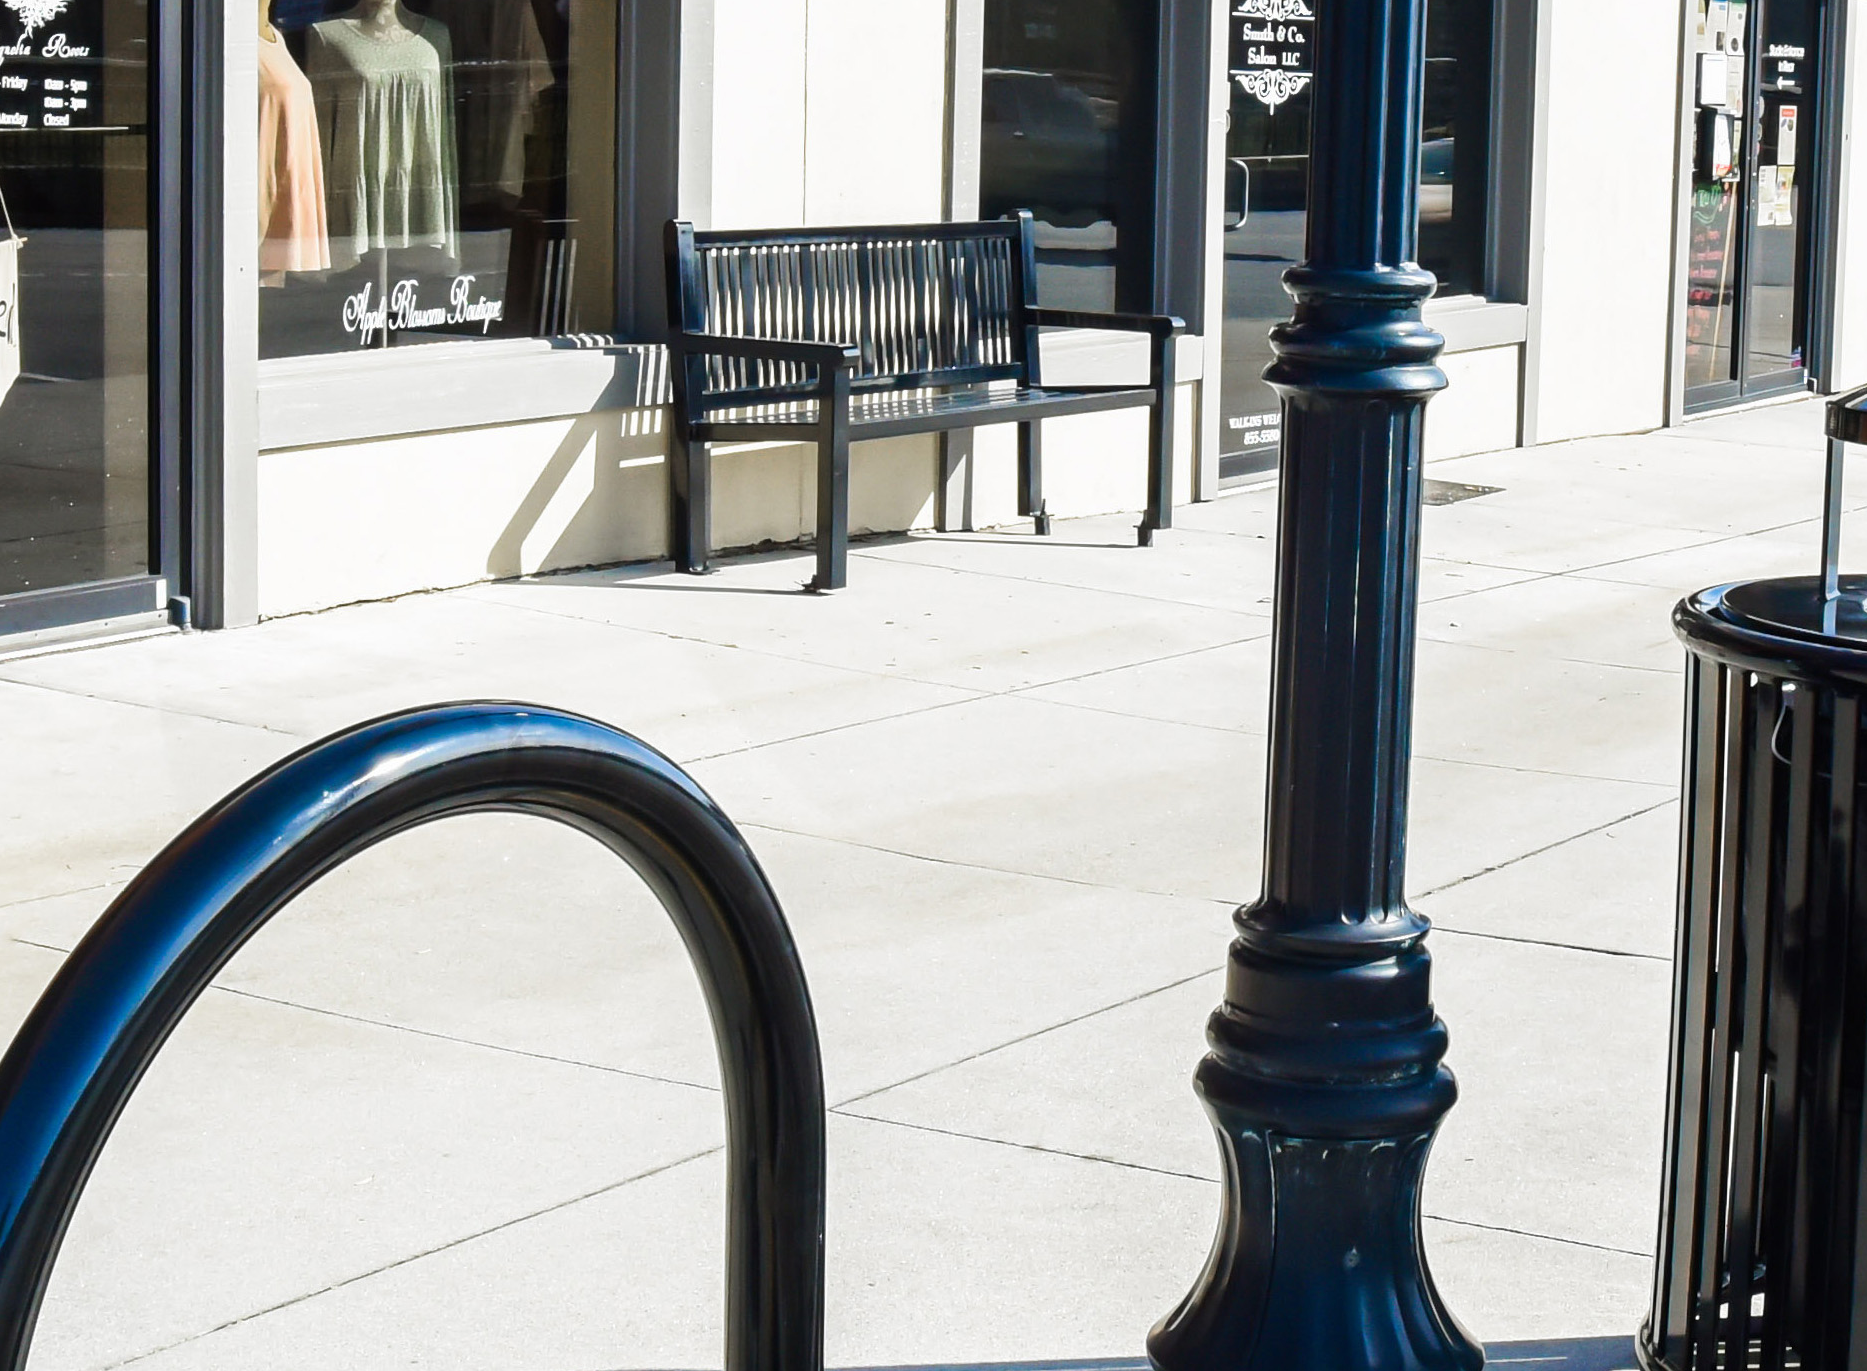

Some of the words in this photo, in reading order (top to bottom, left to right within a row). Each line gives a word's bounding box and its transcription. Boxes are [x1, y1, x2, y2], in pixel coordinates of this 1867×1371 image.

[1243, 22, 1274, 41] Smith
[1276, 25, 1286, 42] &
[1287, 26, 1306, 43] Co.
[42, 33, 89, 58] Roots
[1248, 45, 1277, 65] Salon
[1282, 52, 1300, 66] LLC
[2, 76, 28, 91] Friday
[43, 114, 70, 126] Closed
[343, 282, 386, 345] Apple
[389, 280, 446, 330] Blossoms
[447, 276, 503, 334] Boutique
